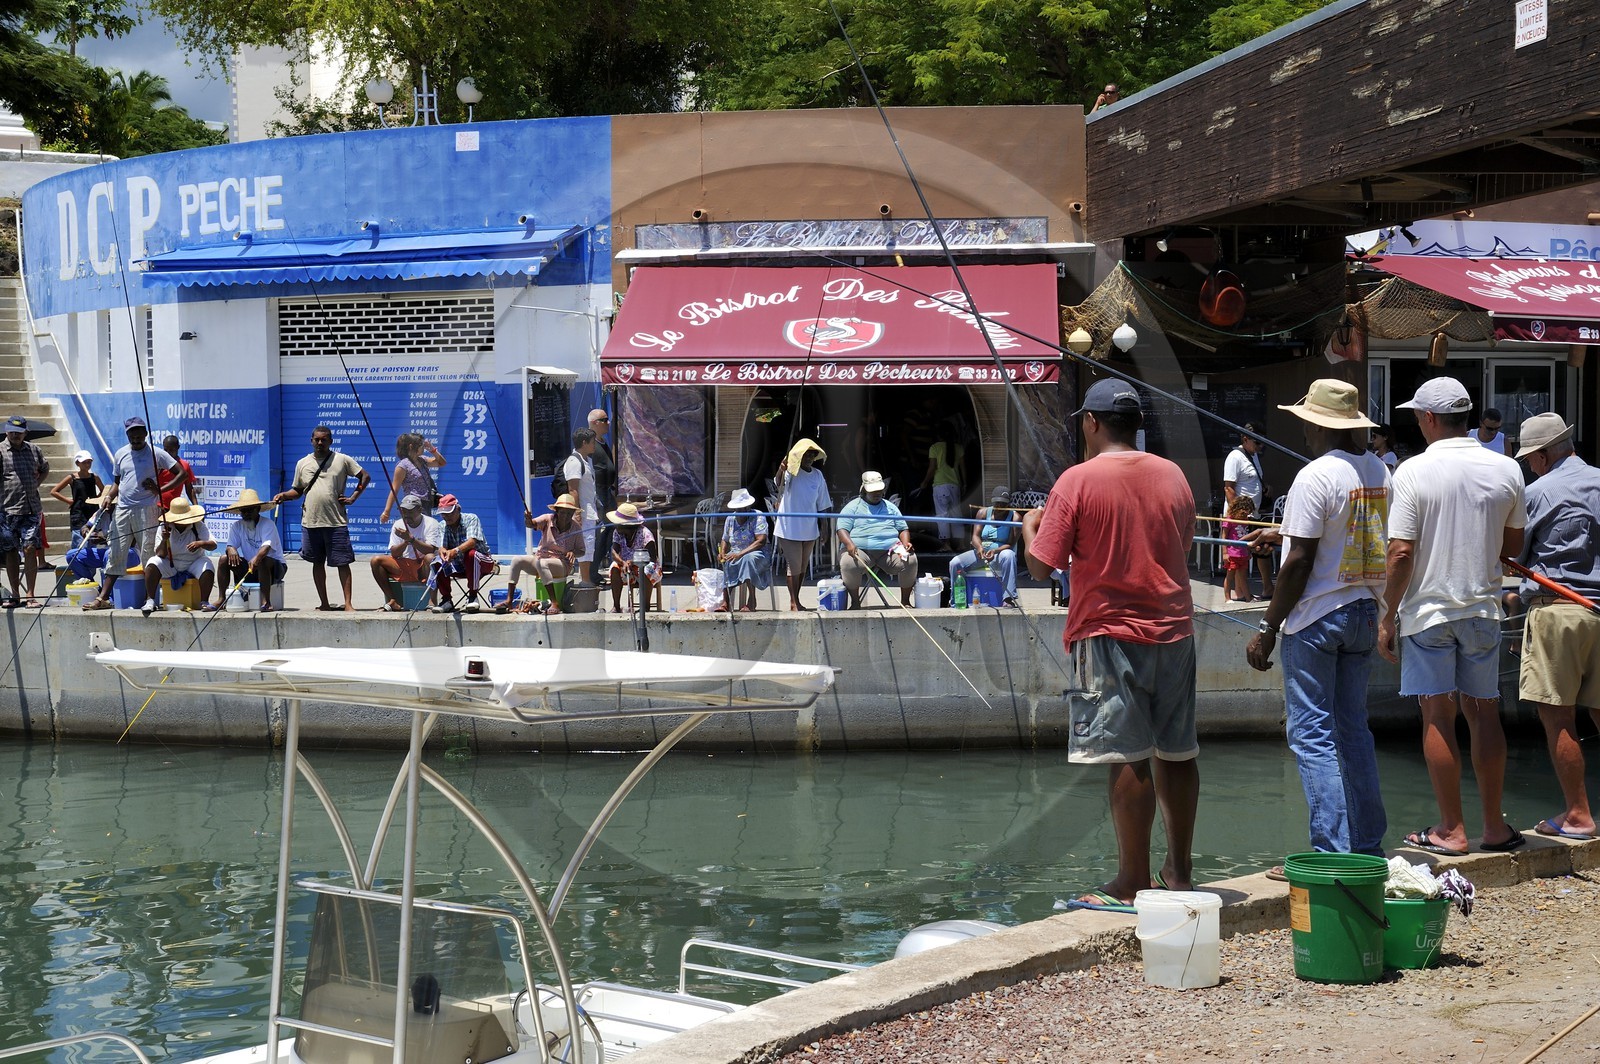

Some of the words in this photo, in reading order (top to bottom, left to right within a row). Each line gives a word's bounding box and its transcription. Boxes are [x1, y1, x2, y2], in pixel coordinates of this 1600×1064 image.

[1516, 35, 1521, 44] 2
[178, 175, 284, 238] PECHE
[776, 220, 859, 247] Bistrot
[629, 330, 684, 352] Le
[678, 285, 802, 326] Bistrot
[822, 278, 900, 304] Des
[657, 370, 669, 381] 33
[672, 370, 683, 381] 21
[685, 370, 697, 381] 02
[701, 363, 732, 381] Le
[738, 362, 814, 381] Bistrot
[818, 362, 858, 380] Des
[862, 361, 953, 381] Pêcheurs
[975, 368, 987, 379] 33
[991, 369, 1002, 379] 21
[463, 390, 485, 400] 0262
[166, 402, 208, 419] OUVERT
[209, 403, 228, 419] LES
[462, 403, 488, 424] 33
[179, 430, 213, 446] SAMEDI
[215, 429, 266, 446] DIMANCHE
[462, 429, 488, 450] 33
[461, 456, 488, 476] 99
[206, 479, 244, 487] RESTAURANT
[208, 489, 218, 498] Le
[222, 522, 228, 530] 33
